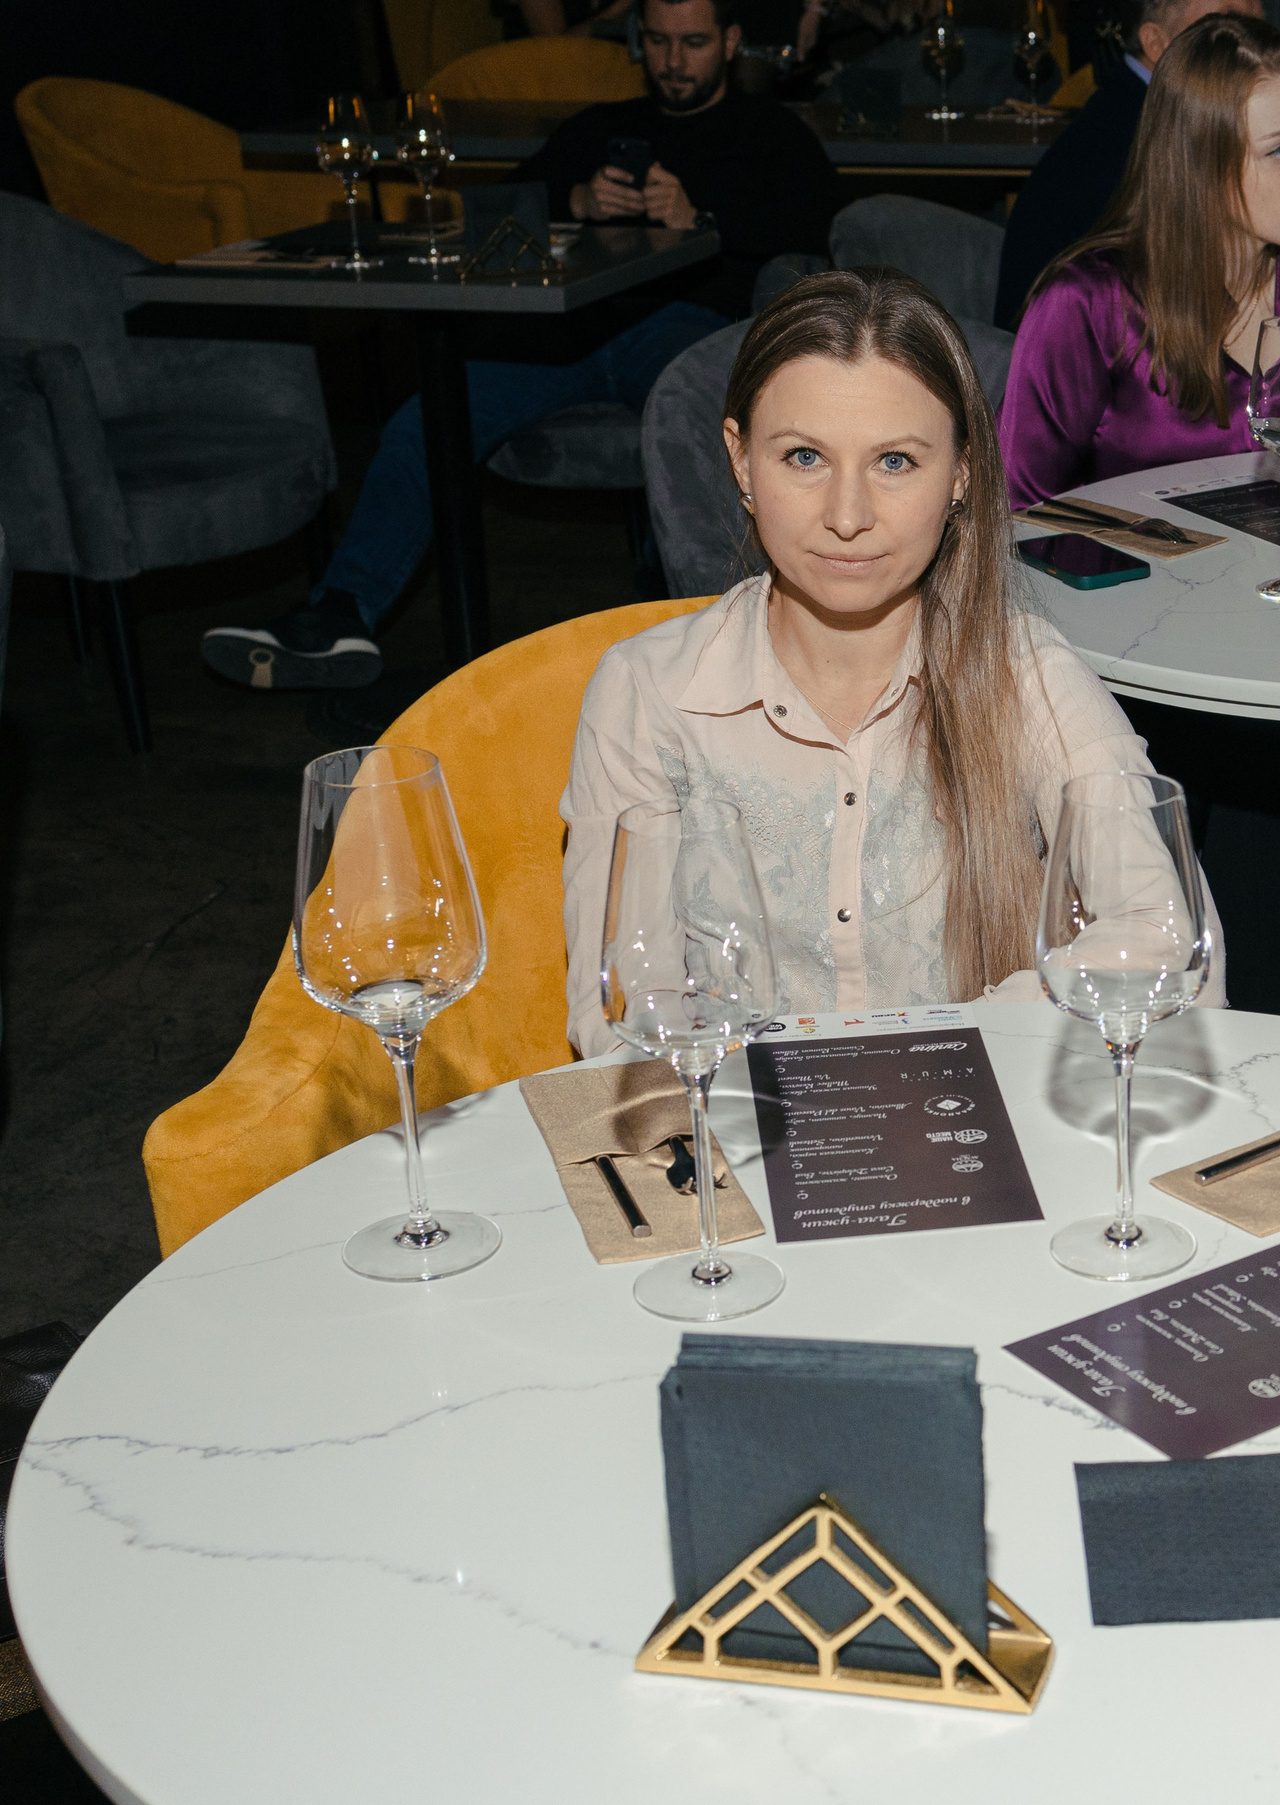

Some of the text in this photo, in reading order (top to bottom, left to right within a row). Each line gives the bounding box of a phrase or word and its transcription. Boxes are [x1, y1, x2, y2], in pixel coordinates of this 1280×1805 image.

[909, 1042, 967, 1052] Cantina
[825, 1108, 838, 1116] del
[928, 1135, 953, 1143] НАШЕ
[793, 1196, 971, 1220] в поддержку студентов
[802, 1213, 907, 1228] Гала-ужин
[1047, 1344, 1127, 1397] Гала-ужин
